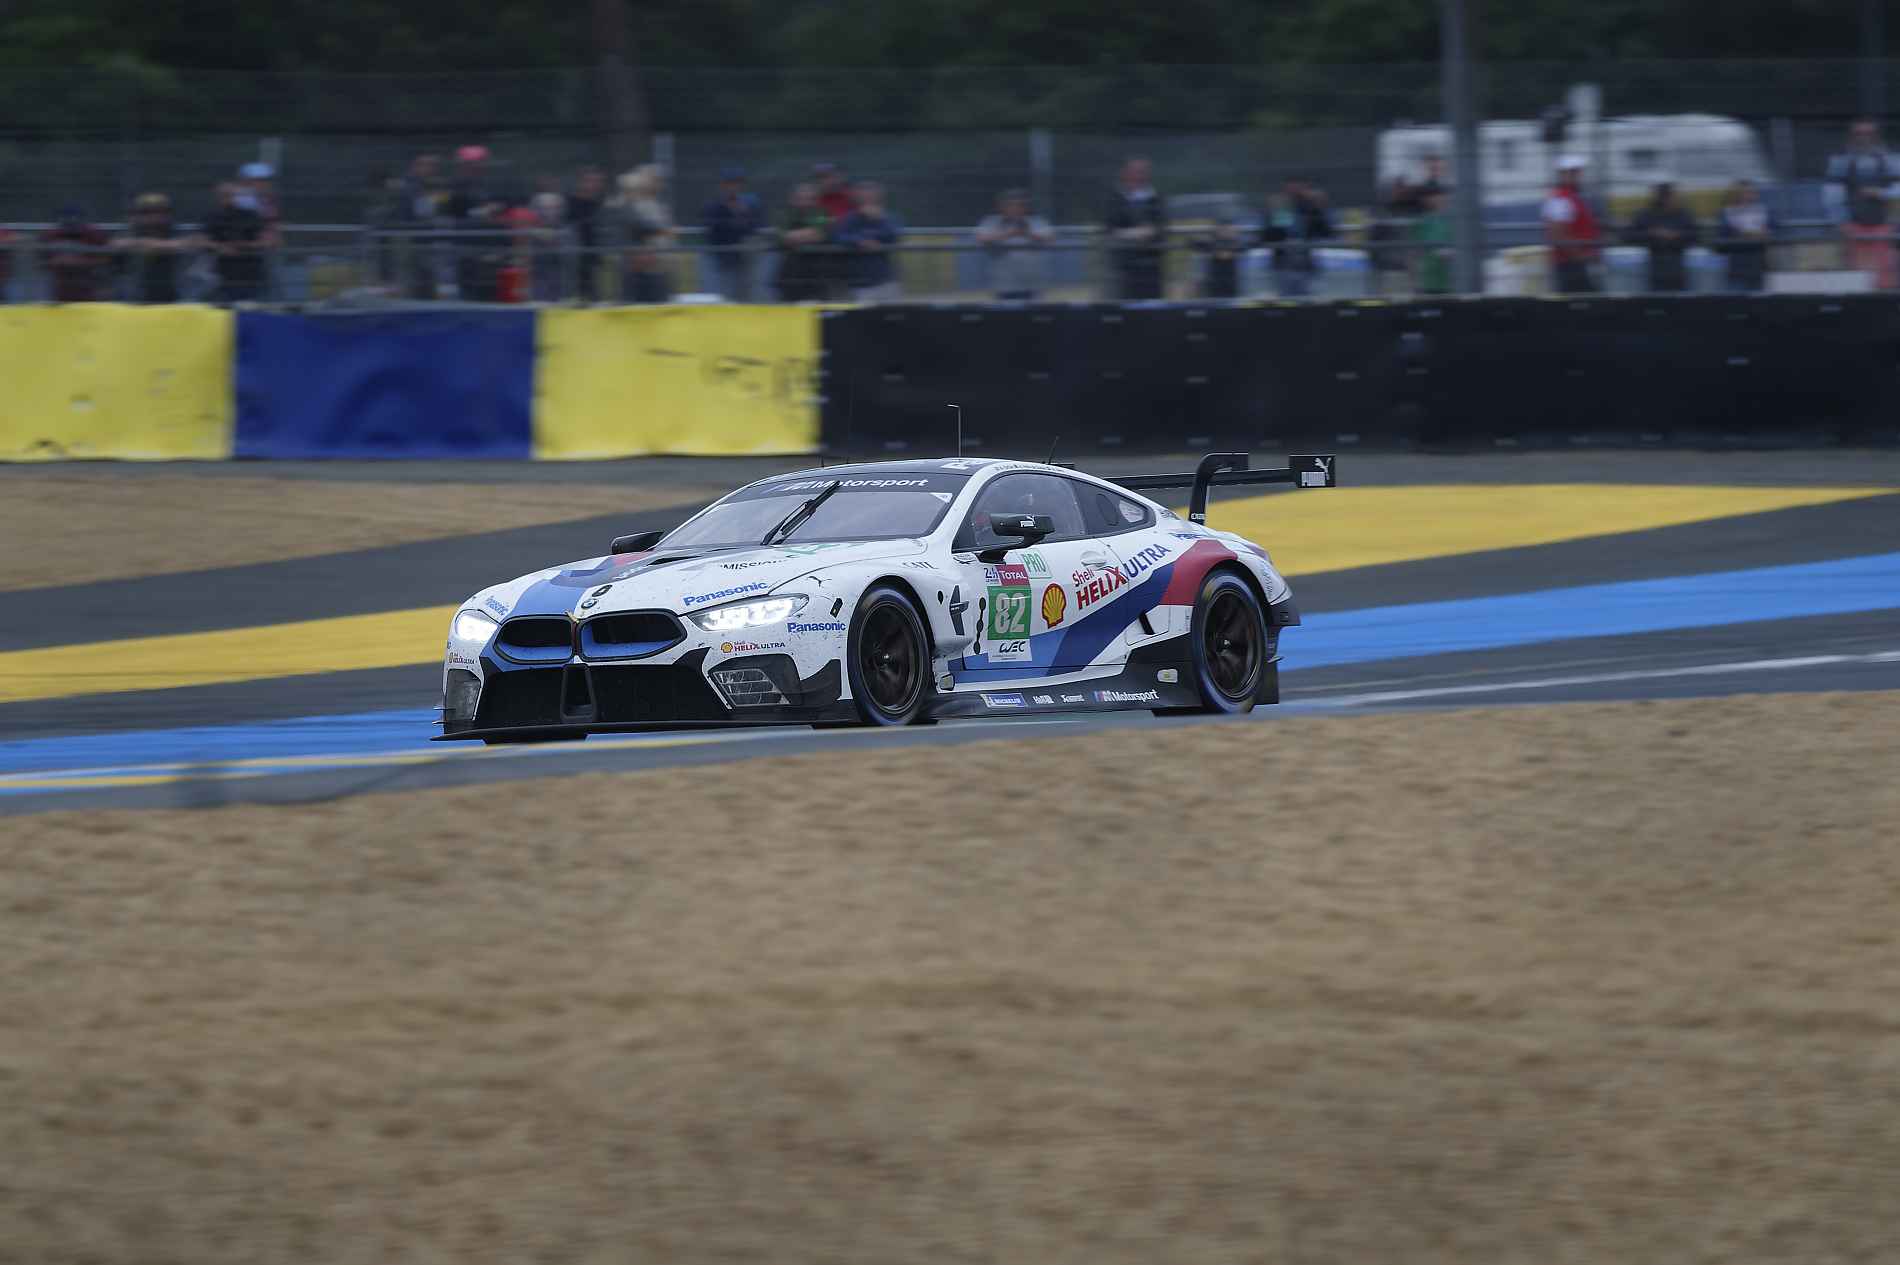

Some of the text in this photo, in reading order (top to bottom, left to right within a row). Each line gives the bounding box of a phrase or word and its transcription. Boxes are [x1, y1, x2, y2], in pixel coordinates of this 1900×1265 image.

[1022, 552, 1047, 573] PRO
[1000, 570, 1028, 580] TOTAL
[1072, 568, 1095, 588] Shell
[1075, 543, 1172, 610] HELIX ULTRA
[682, 581, 768, 607] Panasonic
[994, 592, 1026, 634] 82
[787, 621, 846, 633] Panasonic
[734, 642, 760, 652] HELIX
[1000, 641, 1026, 653] WEC
[1113, 689, 1160, 703] Motorsport
